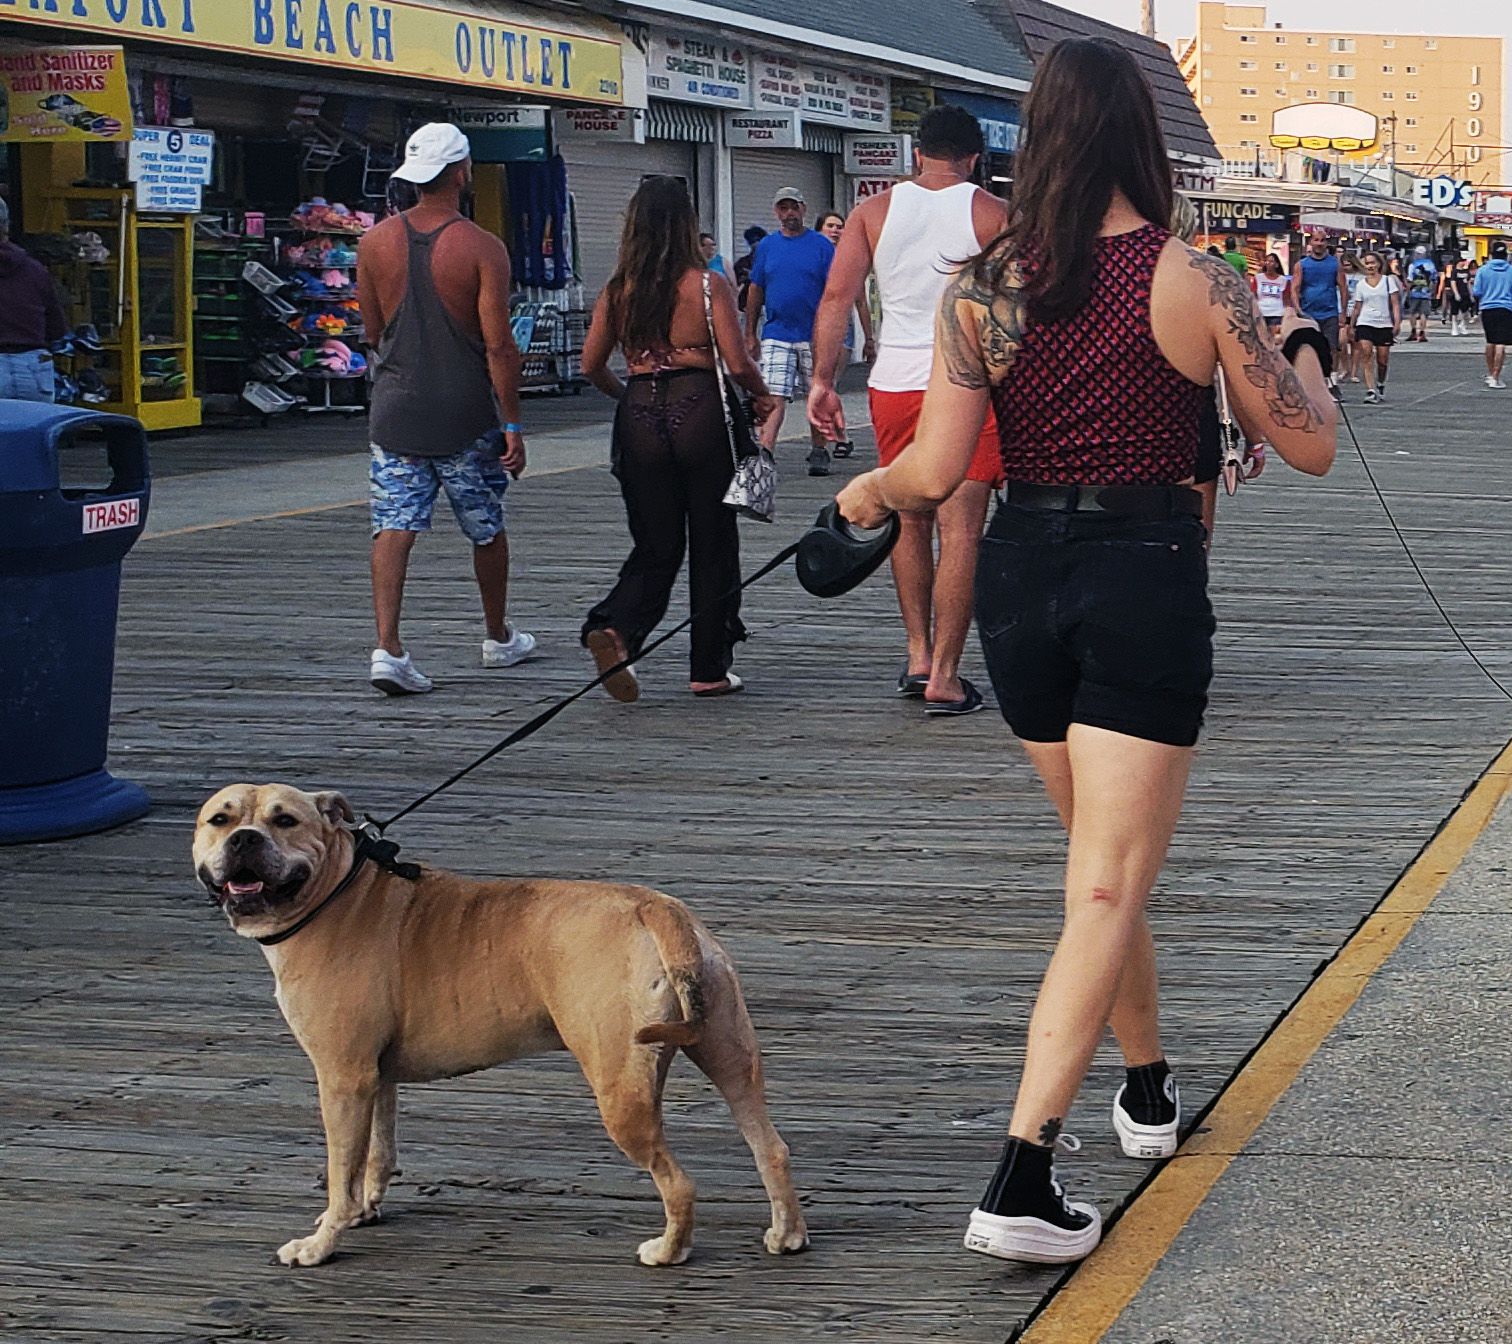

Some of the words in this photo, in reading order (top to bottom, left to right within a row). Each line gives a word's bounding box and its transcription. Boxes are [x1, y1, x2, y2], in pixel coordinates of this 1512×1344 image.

[456, 22, 571, 89] OUTLET
[684, 39, 716, 59] STEAK
[42, 50, 115, 70] Sanitizer
[666, 56, 714, 78] SPAGHETTI
[718, 65, 746, 84] HOUSE
[11, 72, 42, 91] and
[47, 73, 104, 91] Masks
[454, 109, 519, 125] Newport
[1466, 65, 1482, 163] 1900
[574, 121, 618, 131] HOUSE
[732, 118, 789, 128] RESTAURANT
[189, 134, 209, 146] DEAL
[747, 129, 774, 139] PIZZA
[853, 150, 898, 158] PANCAKE
[859, 158, 894, 166] HOUSE
[1175, 173, 1214, 191] ATM
[1203, 202, 1271, 219] FUNCADE
[85, 501, 138, 530] TRASH
